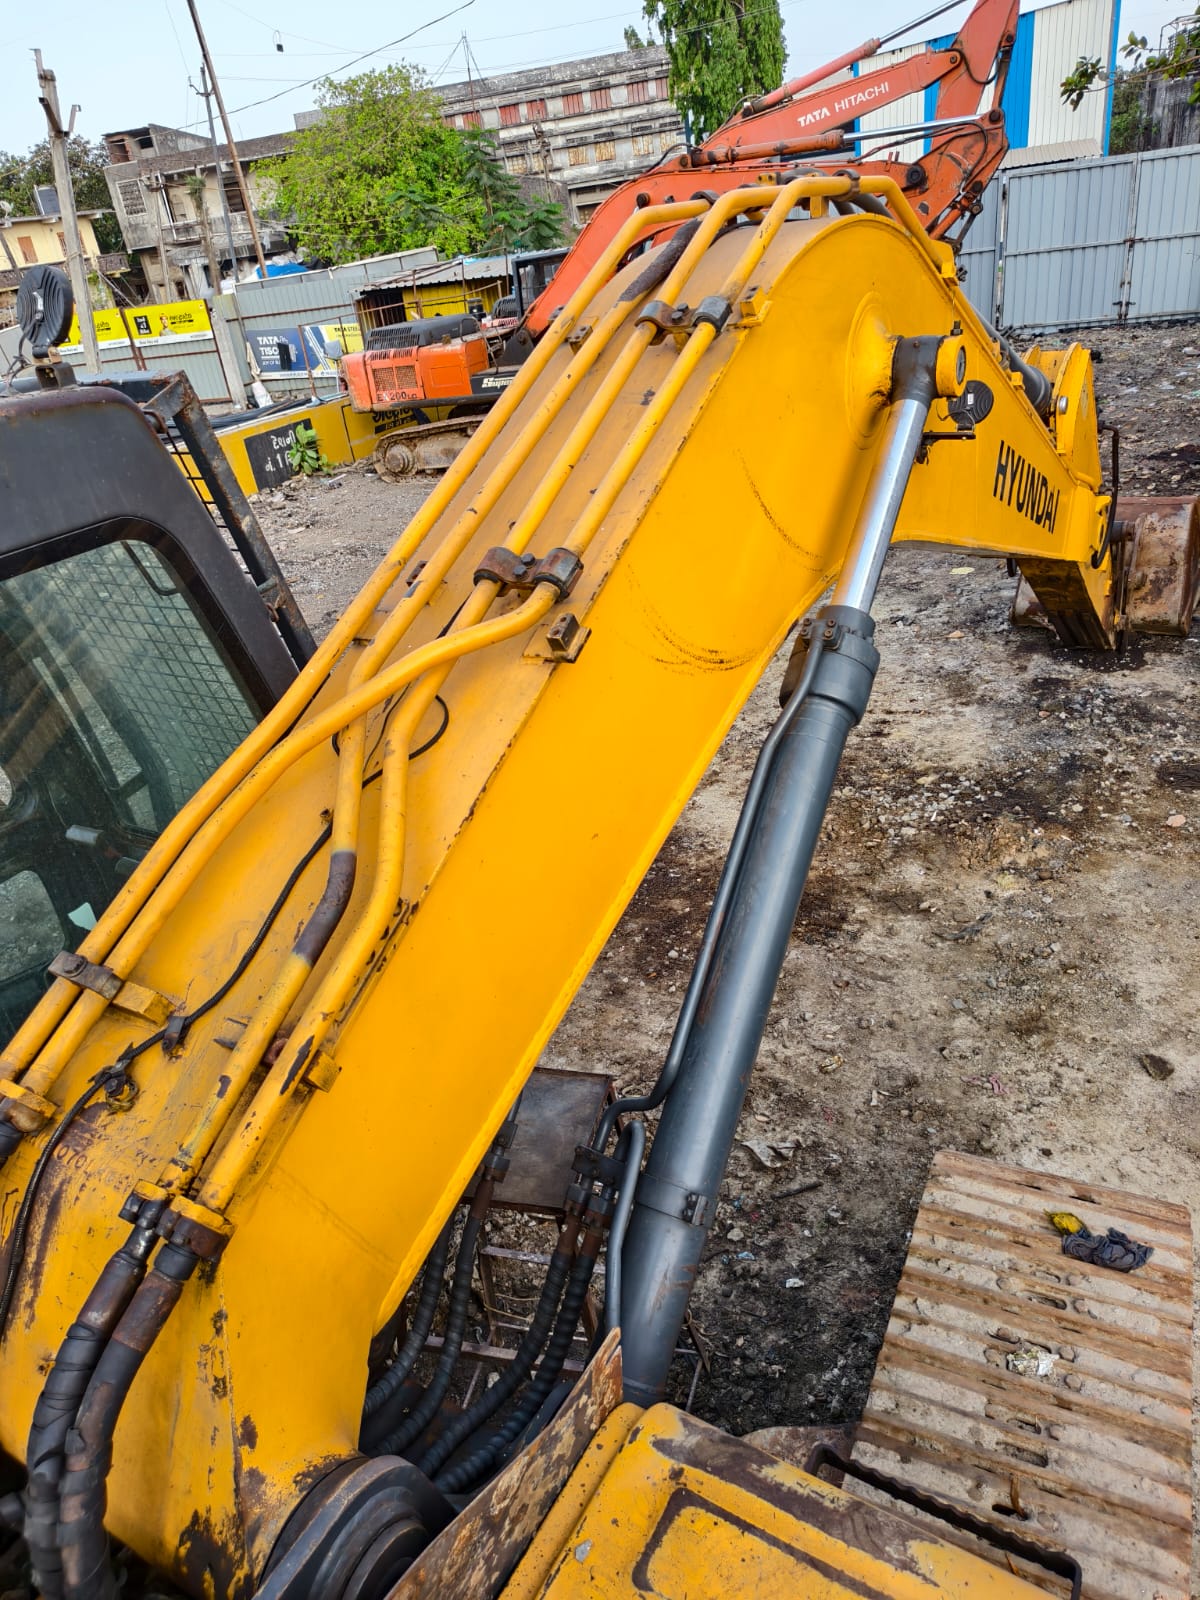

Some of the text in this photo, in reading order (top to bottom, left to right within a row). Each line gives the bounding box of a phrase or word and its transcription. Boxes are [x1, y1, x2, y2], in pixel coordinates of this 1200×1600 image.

[797, 82, 889, 127] TATA HITACHI
[257, 336, 279, 345] TATA
[993, 439, 1060, 534] HYUNDAI
